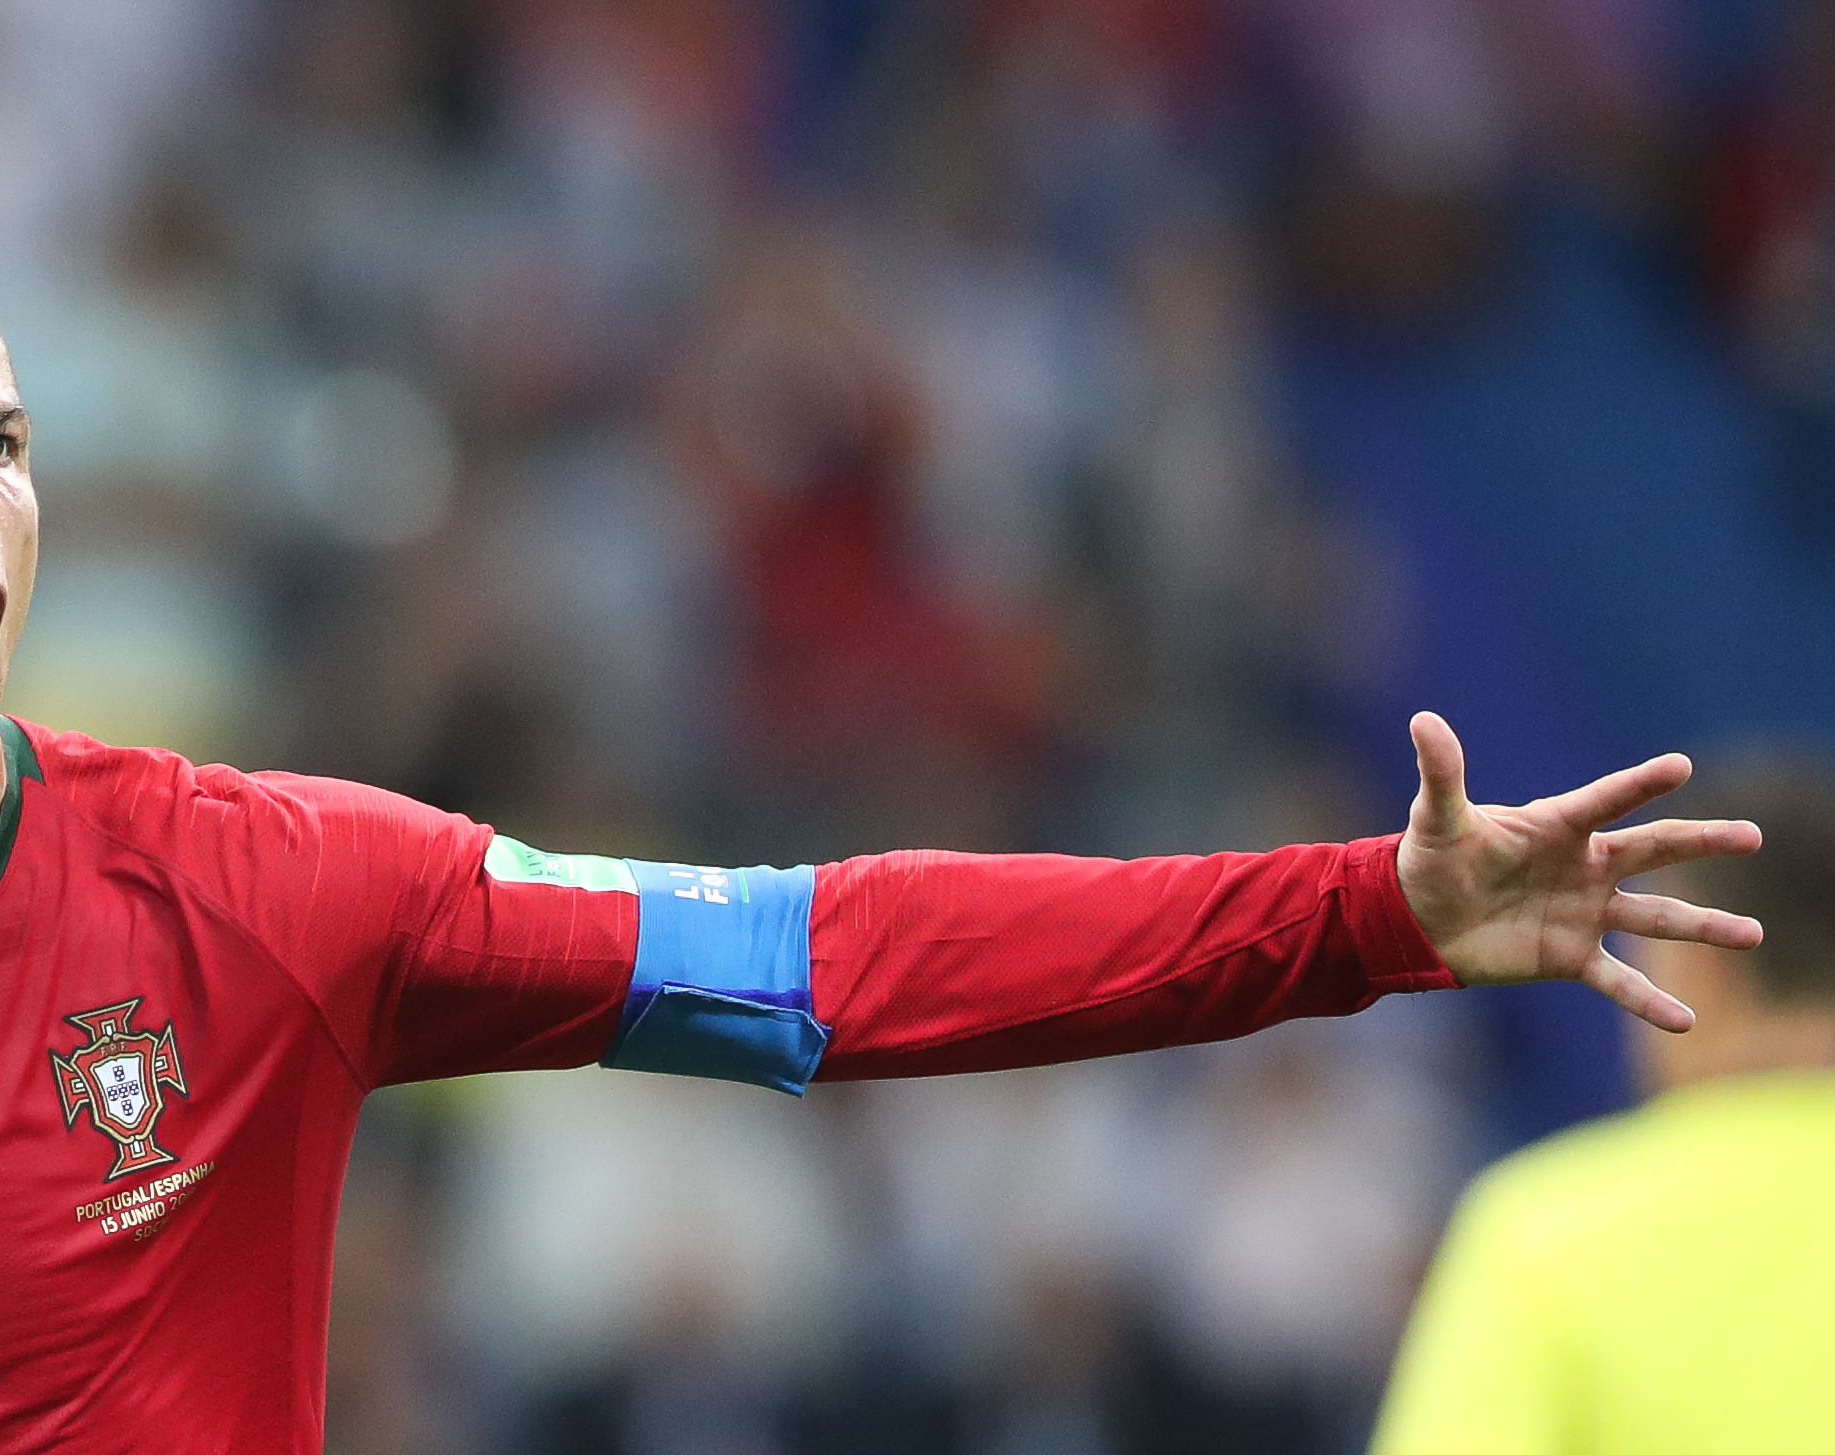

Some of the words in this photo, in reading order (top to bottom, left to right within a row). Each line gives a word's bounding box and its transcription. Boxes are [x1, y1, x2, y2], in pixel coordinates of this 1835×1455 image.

[76, 1161, 216, 1222] PORTUGAL/ESPANHA
[101, 1216, 119, 1235] 15
[120, 1201, 166, 1230] JUNHO
